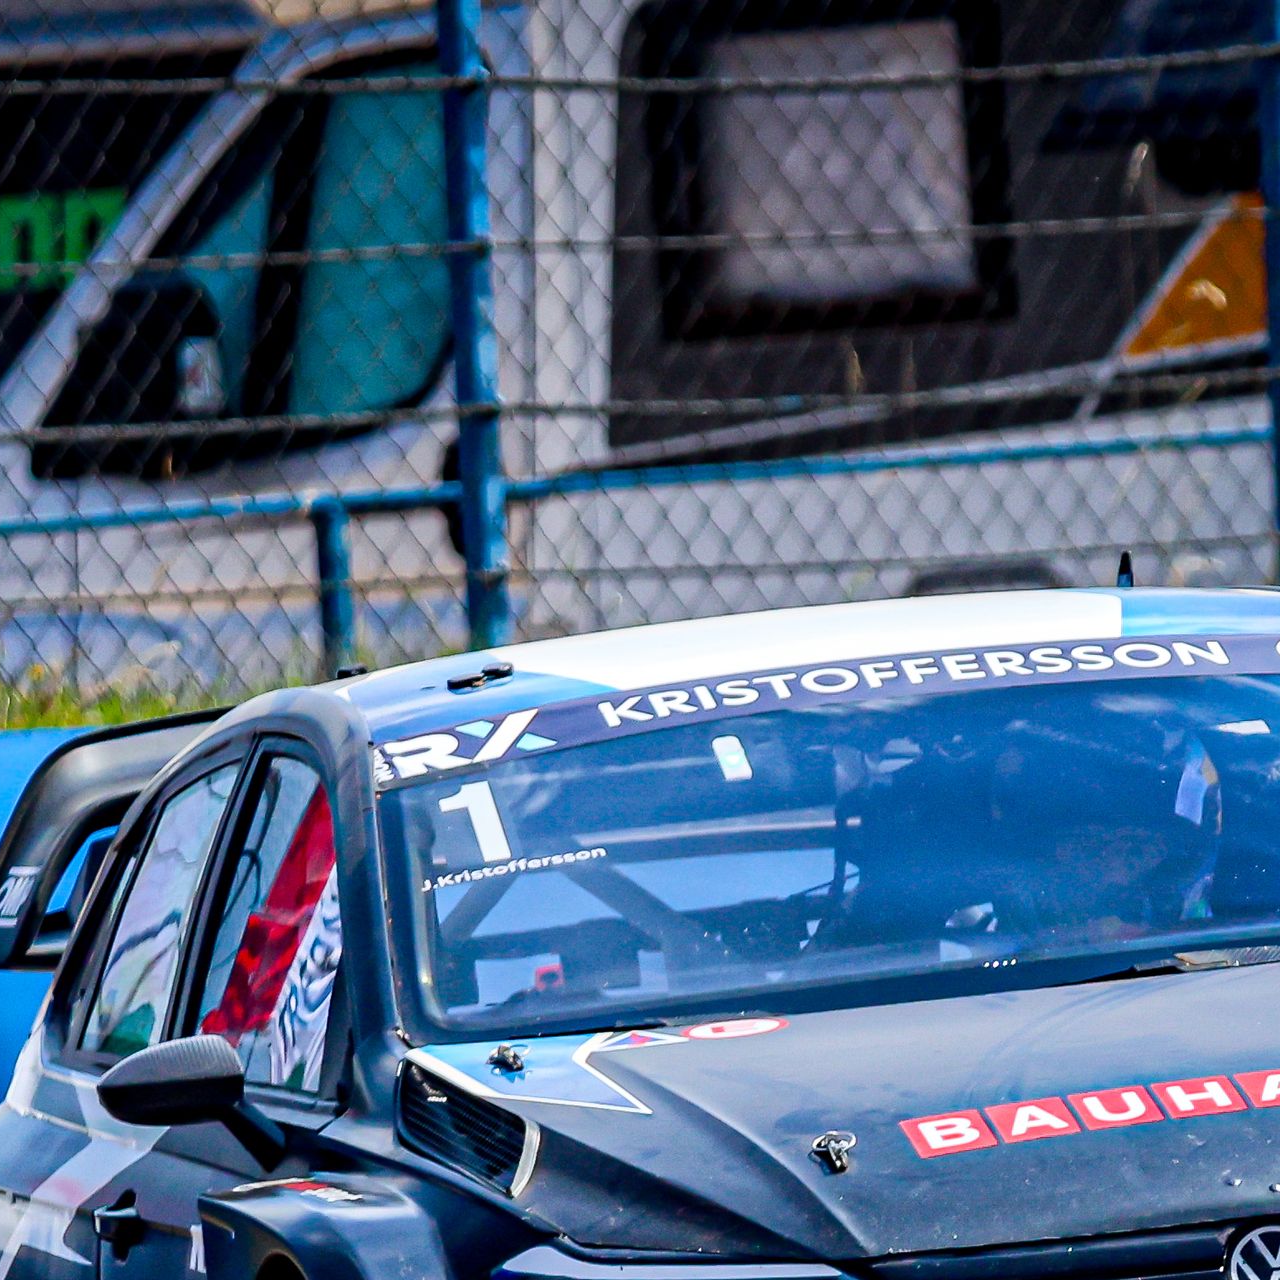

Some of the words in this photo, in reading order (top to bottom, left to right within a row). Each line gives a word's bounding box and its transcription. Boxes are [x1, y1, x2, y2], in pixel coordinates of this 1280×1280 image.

[596, 639, 1231, 728] KRISTOFFERSSON
[382, 707, 559, 780] RX
[438, 780, 513, 863] 1
[420, 846, 608, 893] J.Kristoffersson
